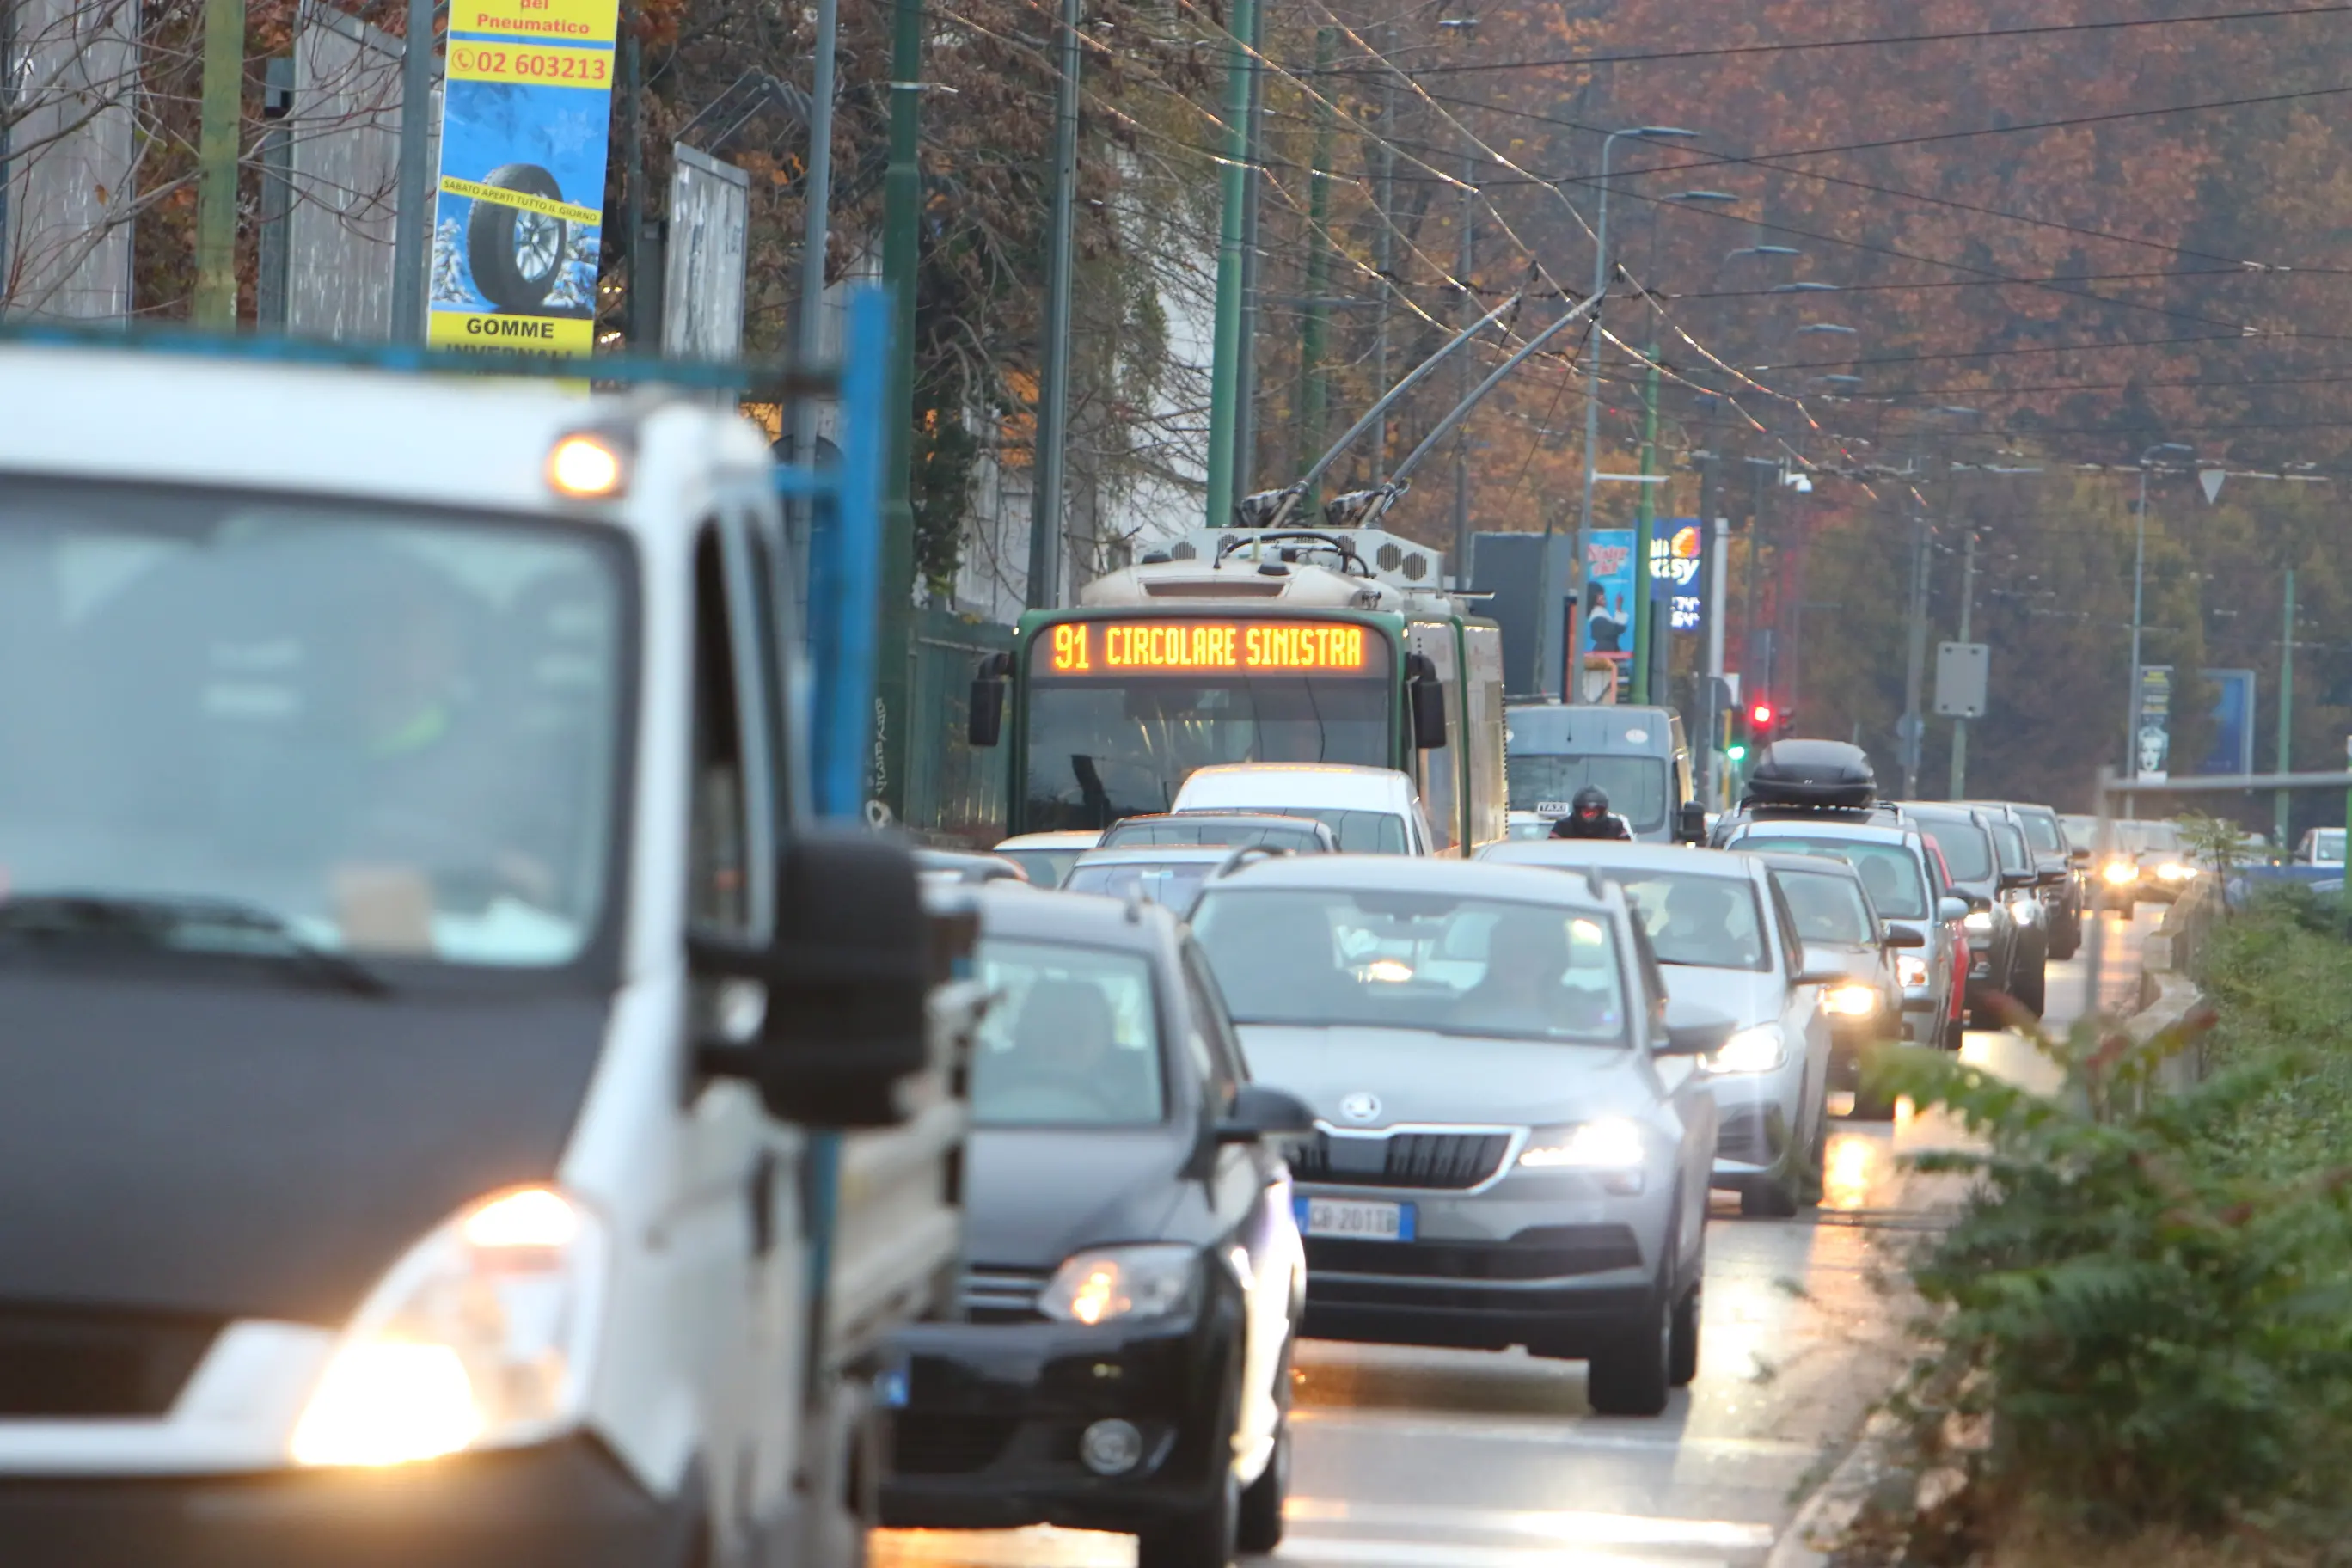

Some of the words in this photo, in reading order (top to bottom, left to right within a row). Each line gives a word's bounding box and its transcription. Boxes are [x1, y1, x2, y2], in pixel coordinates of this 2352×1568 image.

[521, 0, 548, 9] del
[477, 13, 591, 34] Pneumatico
[477, 52, 506, 73] 02
[515, 54, 606, 80] 603213
[444, 179, 480, 195] SABATO
[481, 188, 515, 204] APERTI
[516, 196, 548, 211] TUTTO
[548, 203, 556, 214] IL
[559, 205, 597, 222] GIORNO
[467, 318, 554, 339] GOMME
[1054, 625, 1089, 670] 91
[1106, 628, 1236, 665] CIRCOLARE
[1246, 628, 1362, 666] SINISTRA
[1540, 803, 1566, 812] TAXI
